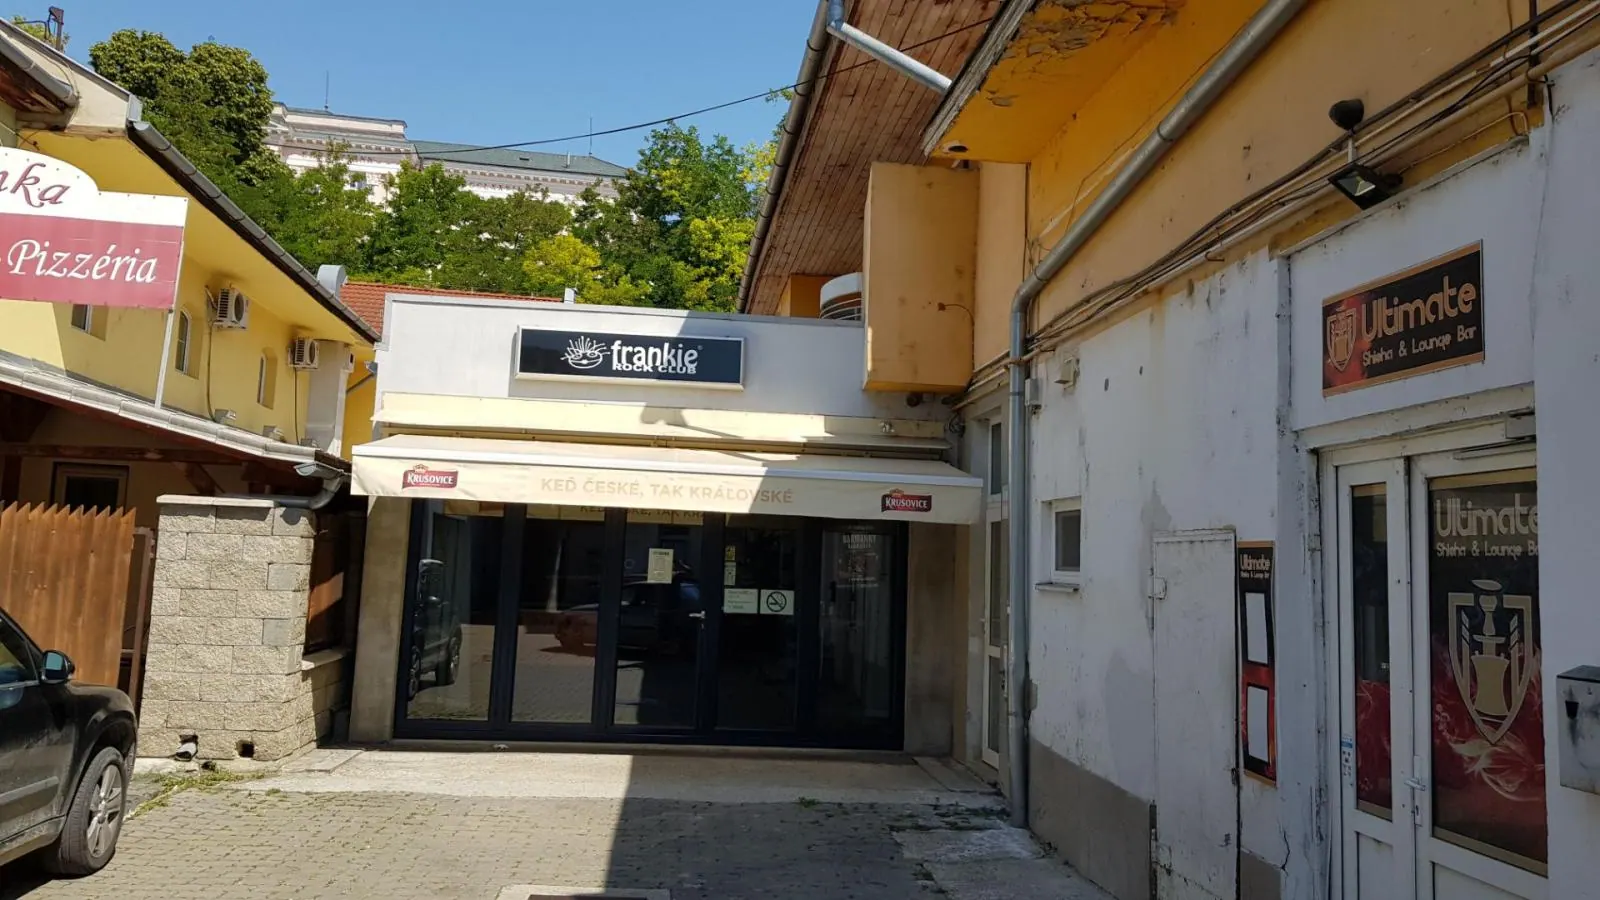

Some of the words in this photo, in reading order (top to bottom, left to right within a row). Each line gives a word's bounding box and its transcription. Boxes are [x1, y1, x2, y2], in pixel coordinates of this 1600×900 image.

[7, 239, 158, 283] Pizzéria
[1362, 275, 1477, 342] Ultimate
[611, 340, 698, 368] frankie
[1362, 346, 1393, 367] Shisha
[1399, 340, 1407, 357] &
[1412, 333, 1451, 351] Lounge
[1457, 325, 1477, 342] Bar
[612, 363, 653, 372] ROCK
[658, 365, 697, 375] CLUB
[651, 483, 683, 498] TAK
[1472, 540, 1480, 557] &
[1485, 540, 1522, 561] Lounge
